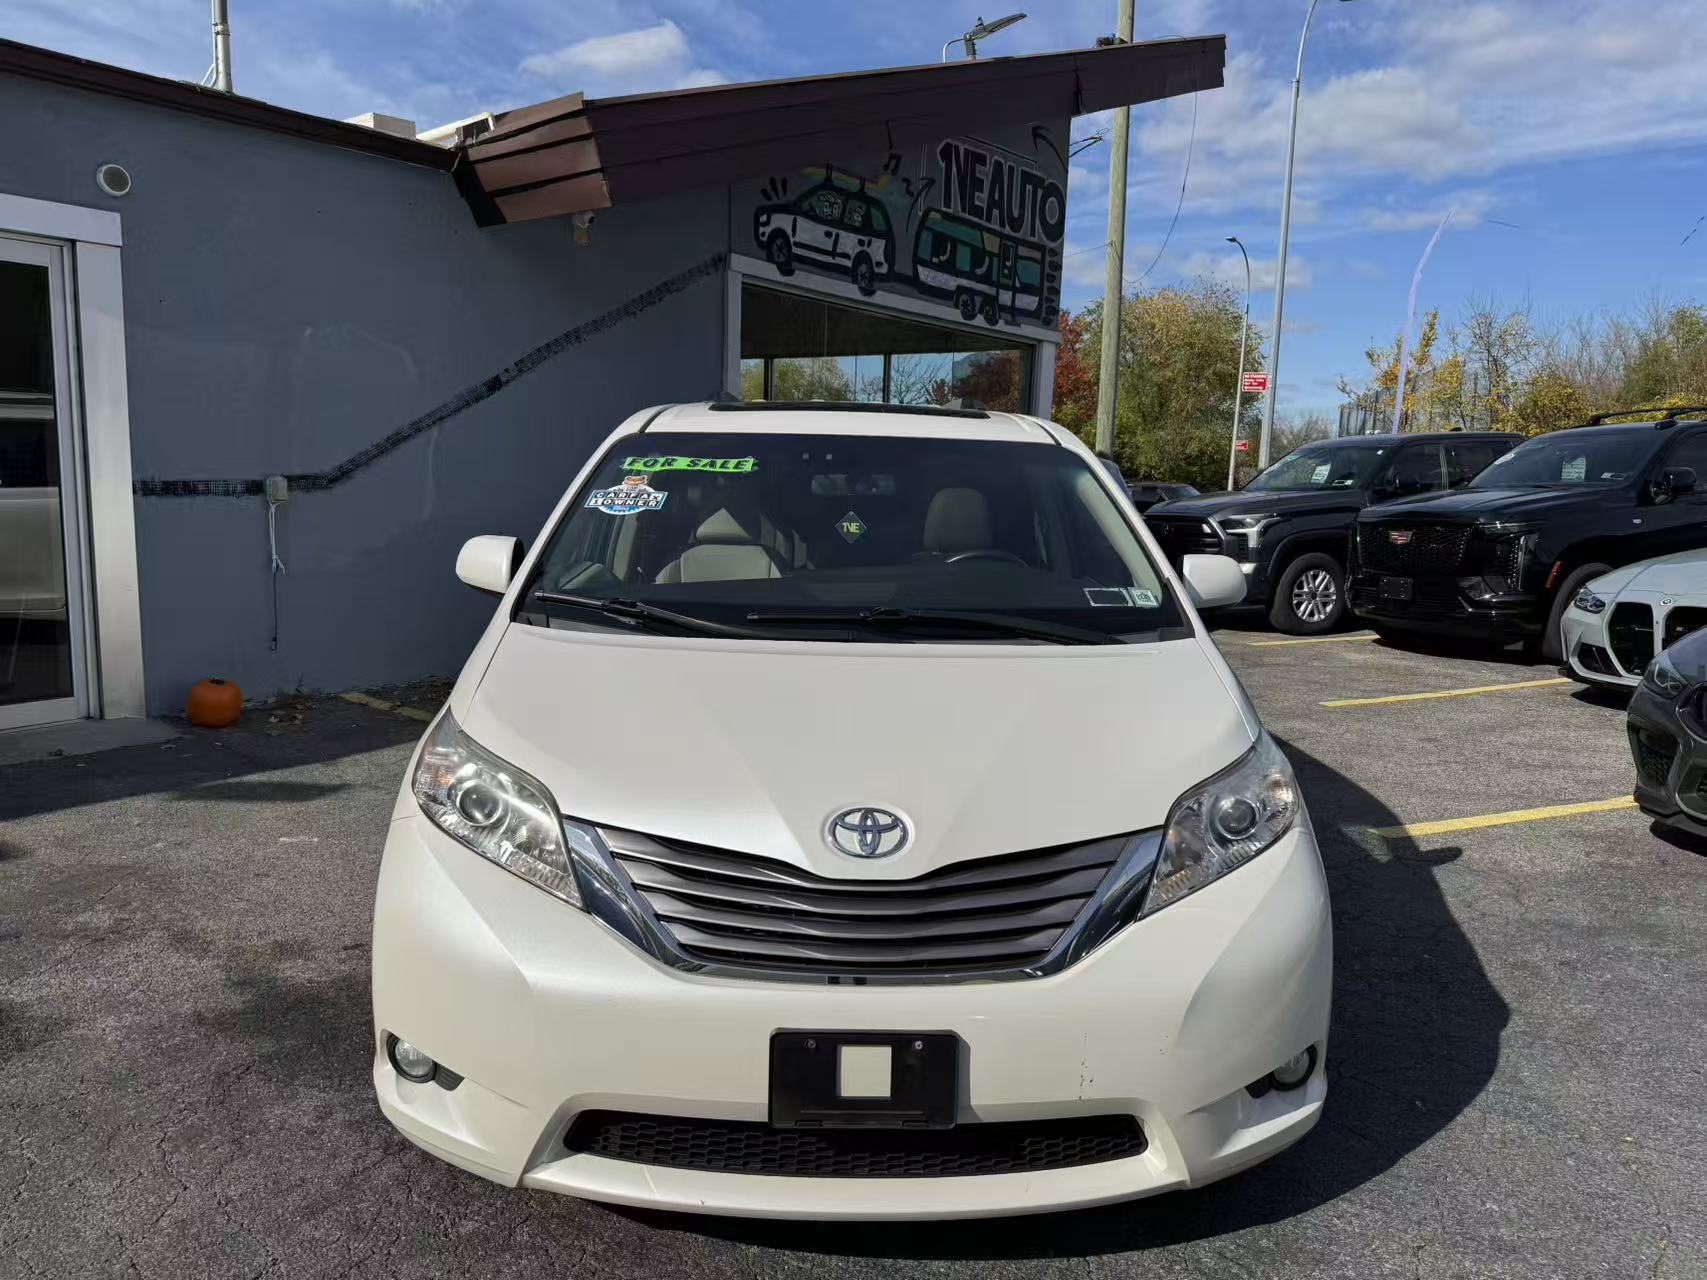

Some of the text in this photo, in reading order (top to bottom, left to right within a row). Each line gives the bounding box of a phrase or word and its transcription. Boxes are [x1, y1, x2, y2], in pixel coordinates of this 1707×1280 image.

[626, 458, 749, 470] FOR SALE
[596, 492, 662, 501] CARFAX
